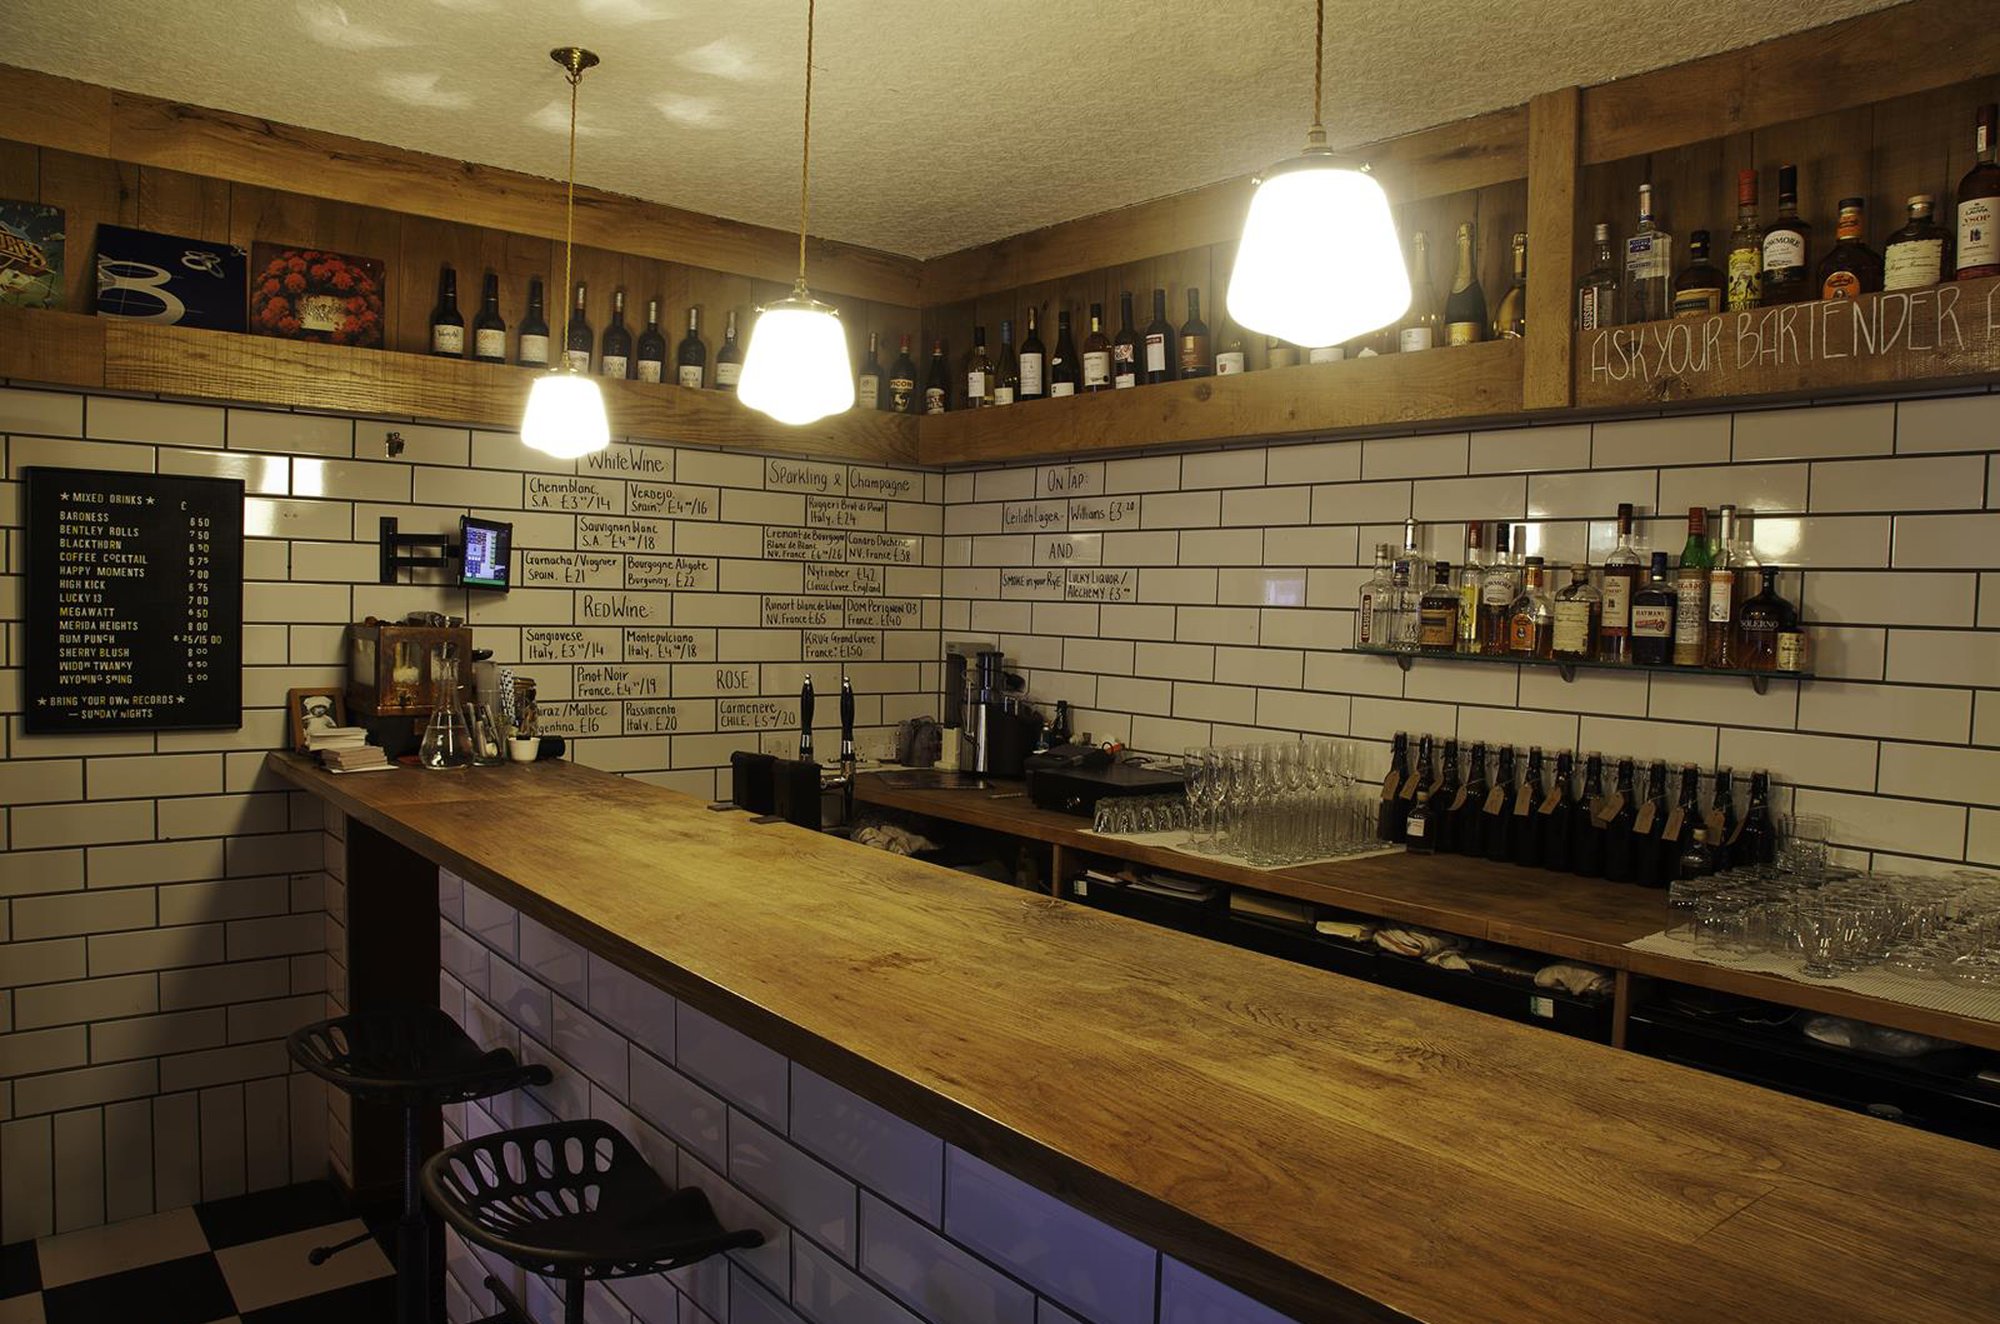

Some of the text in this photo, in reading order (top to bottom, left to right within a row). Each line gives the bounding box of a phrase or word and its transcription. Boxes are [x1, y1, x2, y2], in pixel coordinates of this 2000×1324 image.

[1591, 328, 1649, 385] ASK
[1653, 316, 1724, 376] YOUR
[1736, 286, 1965, 371] BARTENDER
[850, 468, 910, 497] Champagne
[72, 492, 143, 505] MIXED DRINKS
[59, 511, 110, 522] BARONESS
[59, 525, 140, 537] BENTLEY ROLLS
[59, 539, 123, 550] BLACKTHORN
[59, 552, 149, 565] COFFEE COCKTAIL
[59, 566, 145, 578] HAPPY MOMENTS
[59, 580, 106, 590] HIGH KICK
[59, 594, 103, 604] LUCKY 13
[59, 607, 116, 618] MEGAWATT
[59, 621, 139, 631] MERIDA HEIGHTS
[59, 634, 116, 644] RUM PUNCH
[59, 648, 130, 658] SHERRY BLUSH
[59, 661, 133, 671] WIDOW TWANKY
[59, 674, 133, 685] WYOMING SWING
[50, 695, 174, 706] BRING YOUR OWN RECORDS
[81, 709, 153, 720] SUNDAY NIGHTS
